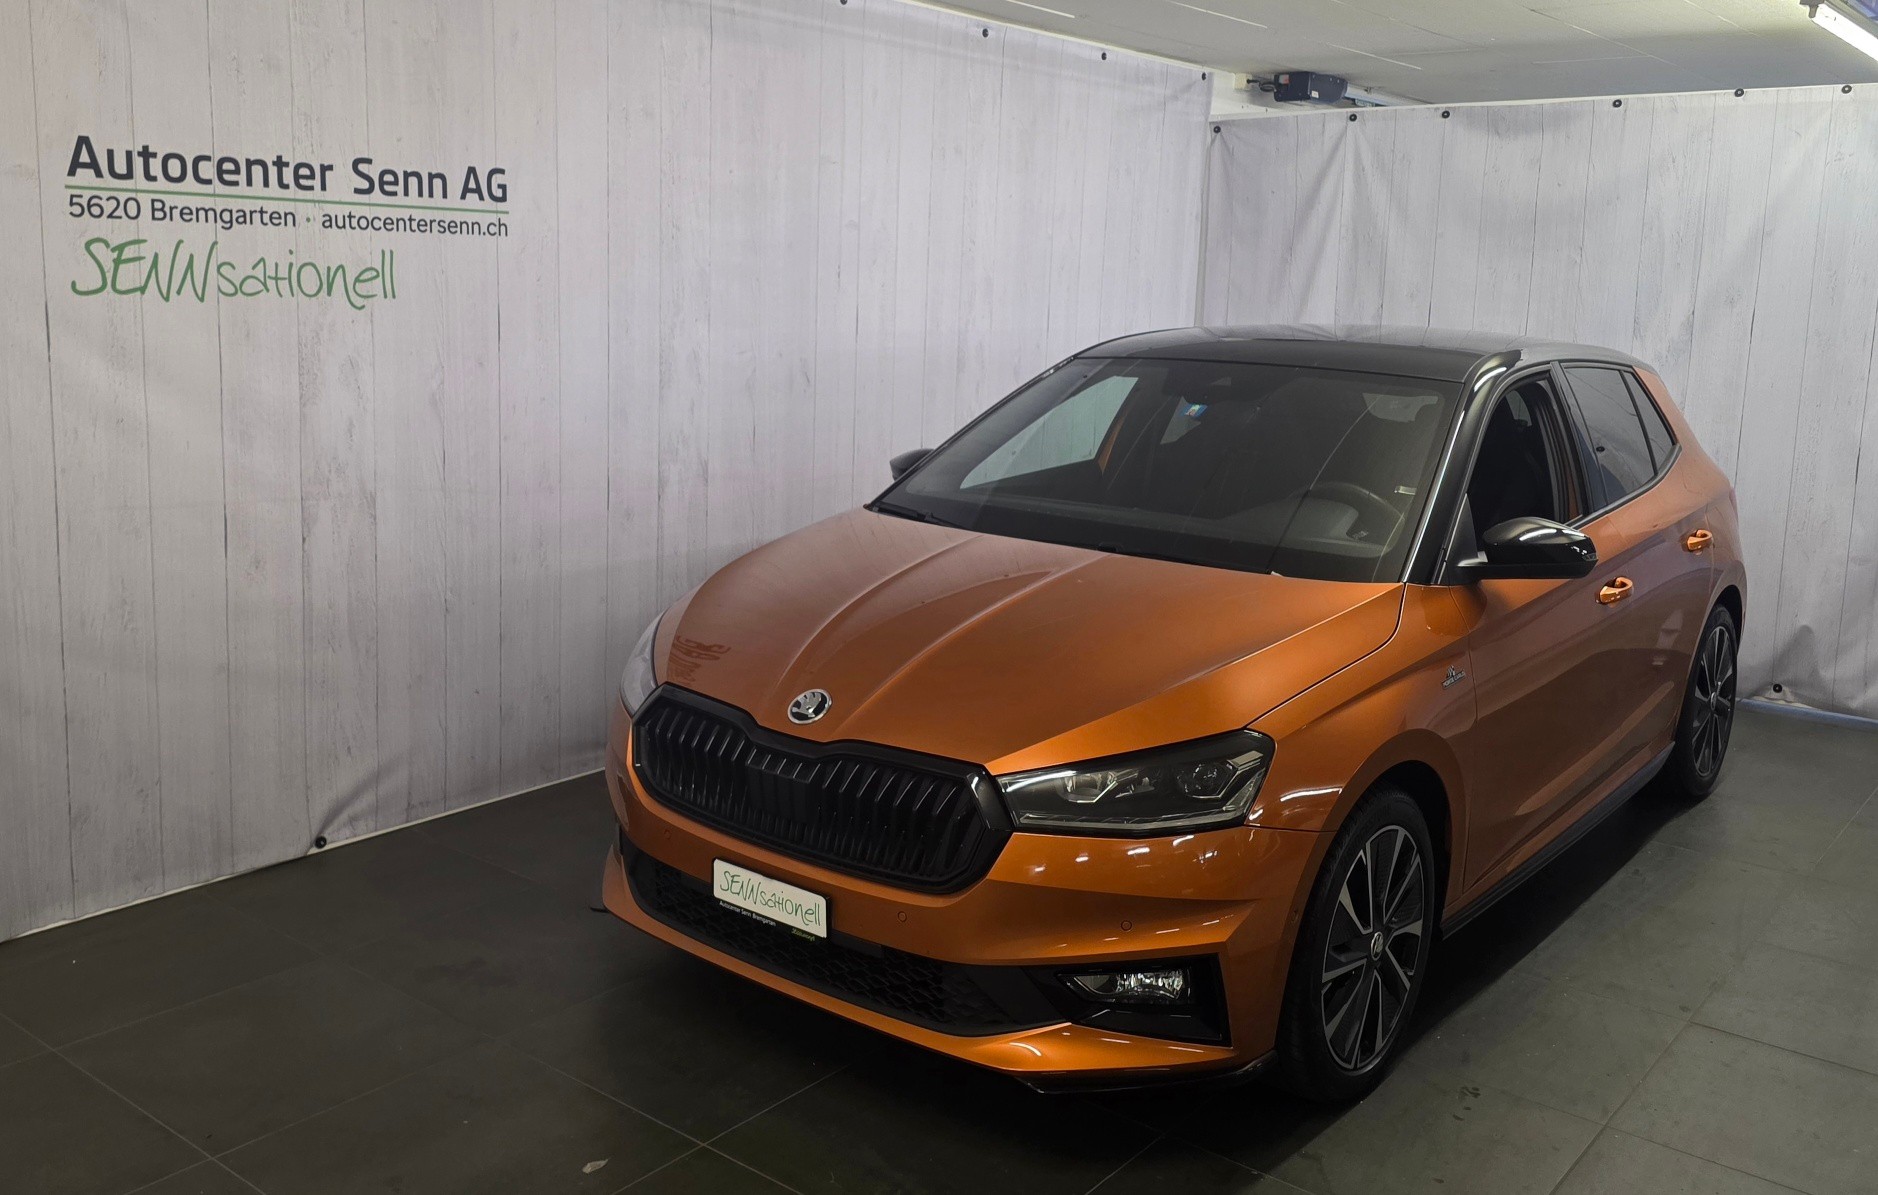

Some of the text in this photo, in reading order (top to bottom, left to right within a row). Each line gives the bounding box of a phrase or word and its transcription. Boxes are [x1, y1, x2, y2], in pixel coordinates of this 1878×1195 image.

[67, 135, 508, 203] Autocenter Senn AG
[69, 194, 508, 237] 5620 Bremgarten autocentersenn.ch
[71, 237, 397, 310] SENNsationell
[720, 871, 821, 926] SENNsationell
